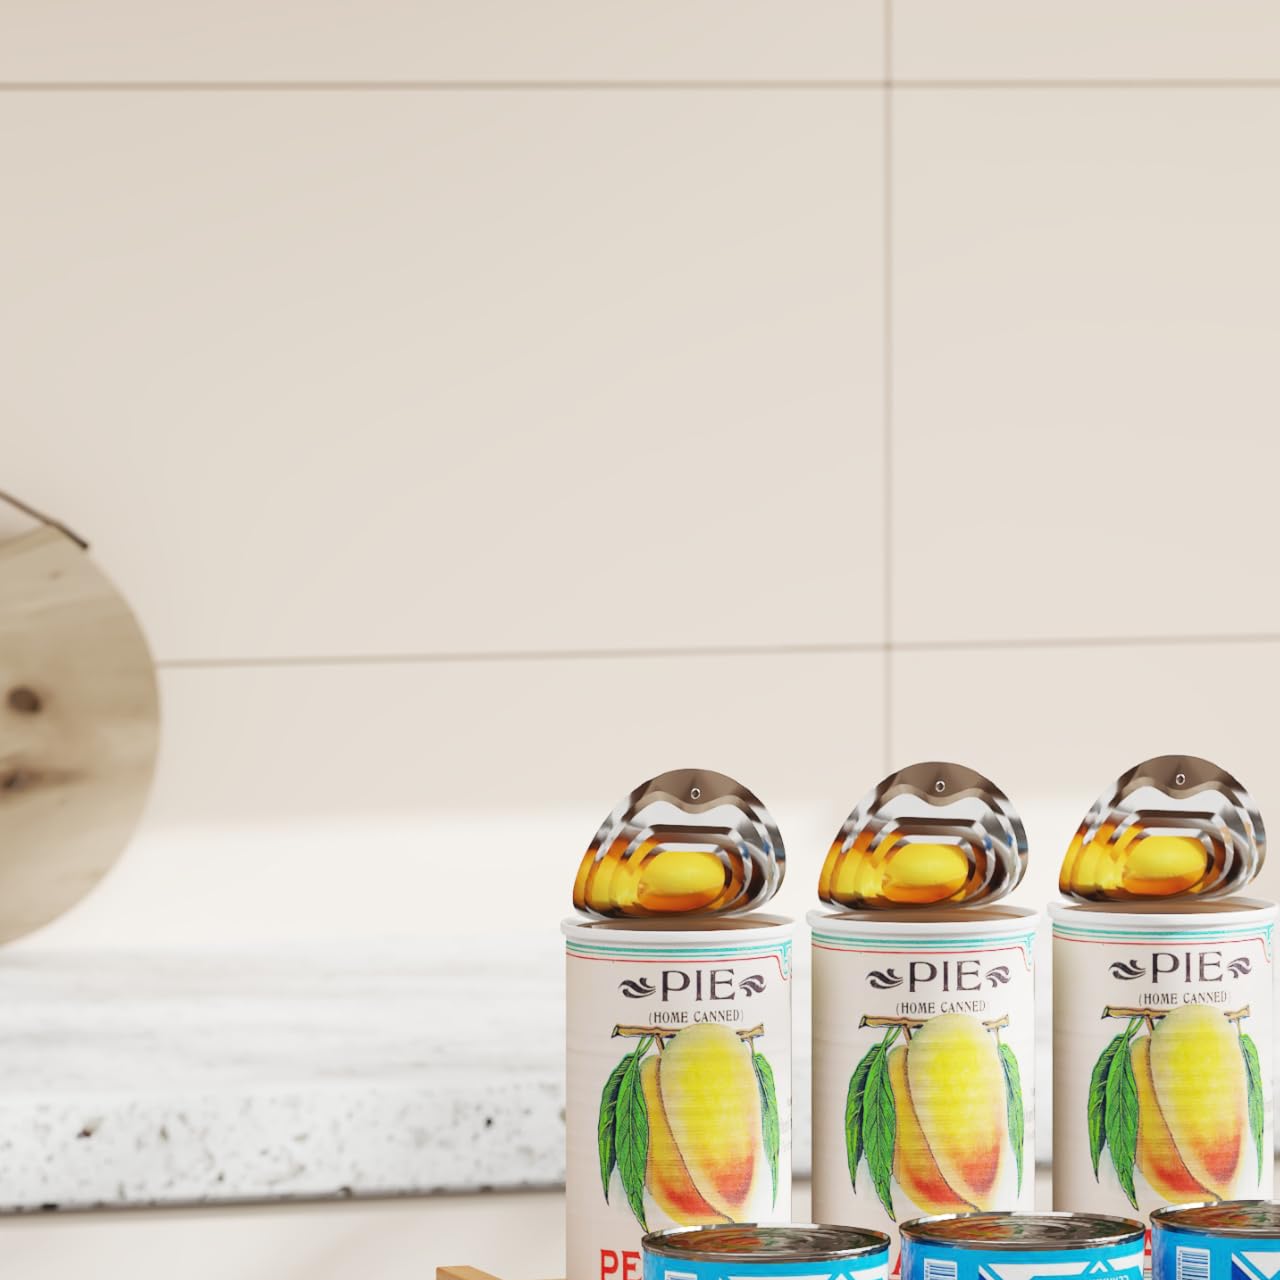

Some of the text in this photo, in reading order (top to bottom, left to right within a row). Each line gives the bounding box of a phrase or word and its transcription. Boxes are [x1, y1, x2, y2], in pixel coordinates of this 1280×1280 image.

[909, 960, 982, 992] PIE
[1152, 951, 1223, 983] PIE
[662, 969, 735, 1001] PIE
[896, 1003, 935, 1015] (HOME
[1138, 992, 1178, 1006] (HOME
[649, 1009, 743, 1025] (HOME CANNED)
